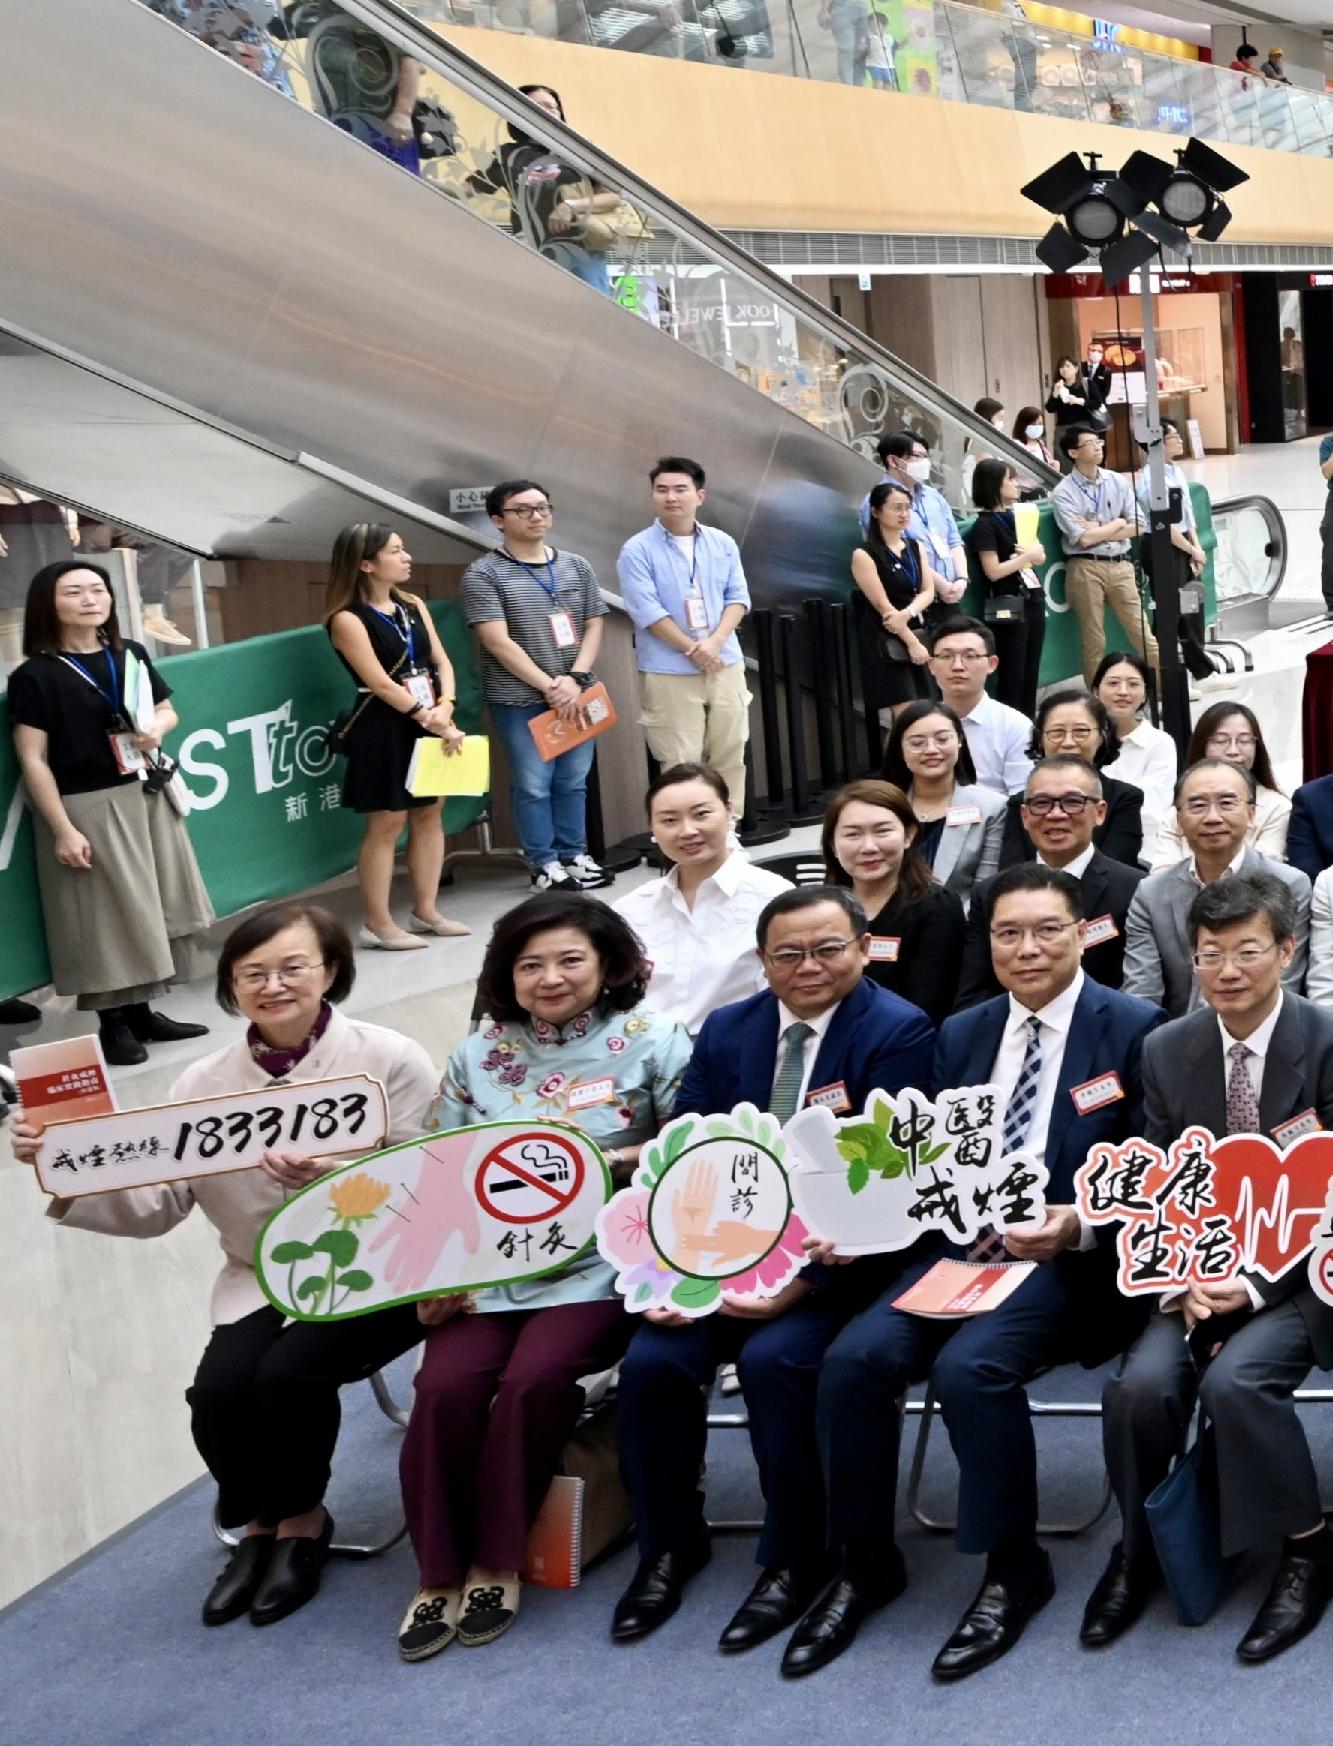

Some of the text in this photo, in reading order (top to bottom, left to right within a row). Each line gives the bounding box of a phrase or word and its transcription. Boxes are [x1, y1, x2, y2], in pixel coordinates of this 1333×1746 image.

[52, 1093, 369, 1173] 戒煙熱線 1833183
[889, 1094, 996, 1178] 中醫
[729, 1151, 759, 1219] 問診
[907, 1160, 1039, 1235] 戒煙
[1088, 1138, 1217, 1216] 健康
[496, 1221, 579, 1262] 針灸
[1131, 1210, 1234, 1282] 生活
